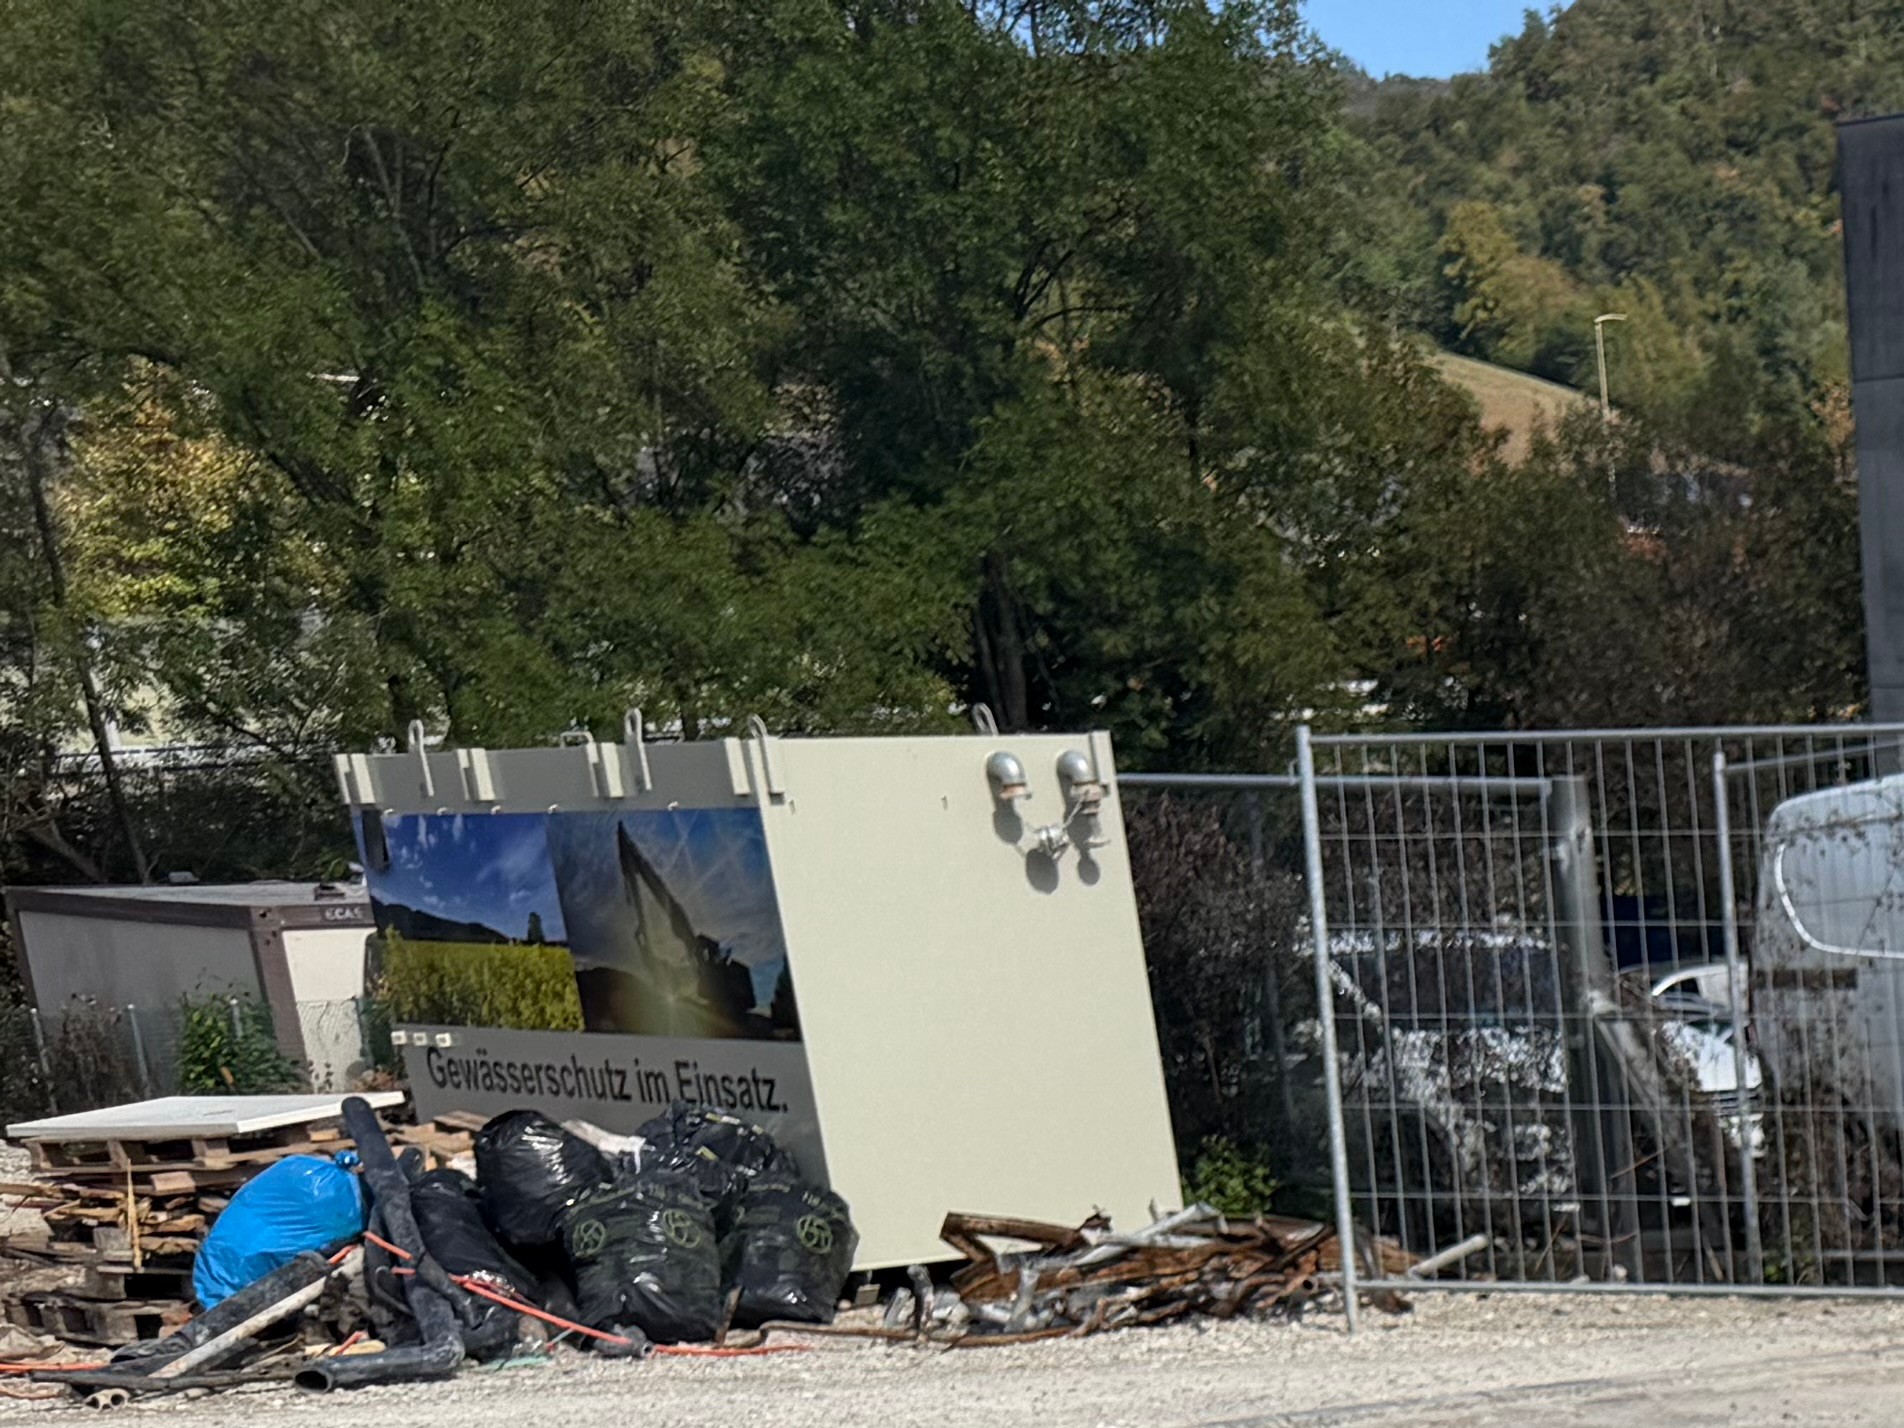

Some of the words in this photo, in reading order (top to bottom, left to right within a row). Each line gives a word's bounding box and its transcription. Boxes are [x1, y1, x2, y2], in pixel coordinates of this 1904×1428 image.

[426, 1046, 632, 1101] Gewässerschutz
[634, 1057, 669, 1104] im
[675, 1060, 789, 1114] Einsatz.
